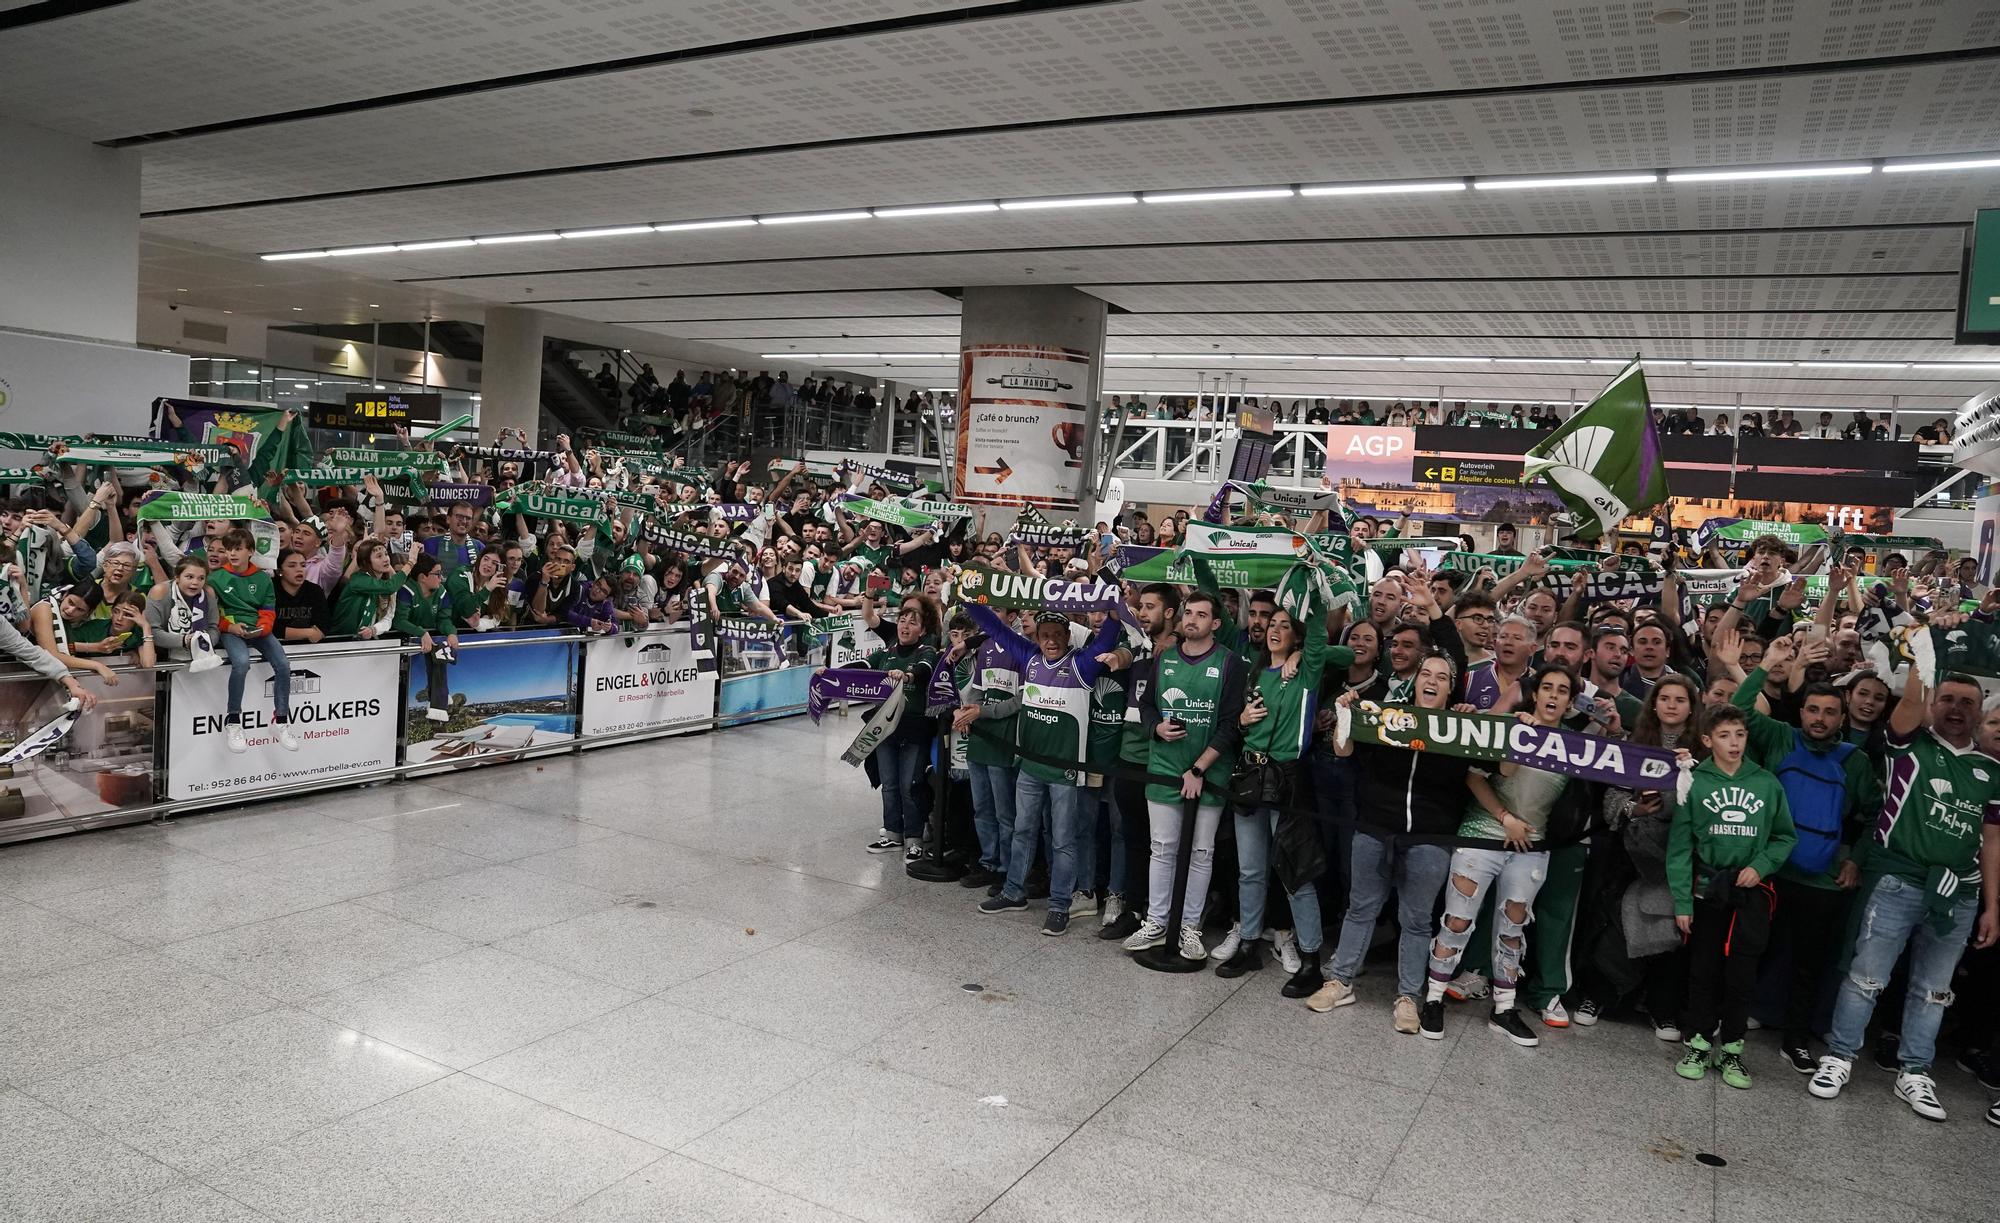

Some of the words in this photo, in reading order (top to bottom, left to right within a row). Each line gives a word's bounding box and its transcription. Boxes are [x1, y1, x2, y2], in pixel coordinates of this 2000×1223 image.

[1010, 378, 1018, 386] LA
[977, 413, 995, 423] ¿Café
[1005, 415, 1039, 424] brunch?
[1346, 435, 1403, 457] AGP
[464, 445, 551, 460] UNICAJA
[847, 459, 910, 483] UICAJA
[1459, 461, 1495, 470] Autoverleih
[1458, 475, 1483, 485] Alquiler
[179, 493, 234, 504] UNICAJA
[427, 488, 480, 500] ALONCESTO
[609, 492, 646, 505] nicaja
[1273, 493, 1306, 505] Unicaja
[172, 504, 246, 518] BALONCESTO
[863, 506, 905, 524] BALONCESTO
[1752, 521, 1791, 532] UNICAJA
[644, 525, 737, 560] UNICAJA
[1229, 540, 1258, 549] Unicaja
[990, 573, 1121, 604] UNICAJA
[1692, 580, 1727, 590] Unicaja
[1699, 594, 1713, 605] 43
[618, 695, 626, 703] El
[627, 693, 652, 702] Rosario
[656, 689, 685, 698] Marbella
[1039, 697, 1066, 707] Unicaja
[1185, 699, 1215, 710] Unicaja
[1027, 709, 1059, 724] málaga
[303, 728, 350, 740] Marbella
[1427, 714, 1625, 774] UNICAJA
[1464, 749, 1582, 774] BALONCESTO
[188, 783, 209, 793] Tel.:
[211, 779, 231, 789] 952
[234, 776, 247, 786] 86
[249, 774, 262, 784] 84
[265, 772, 277, 782] 06
[283, 758, 381, 779] www.marbella-ev.com
[1702, 787, 1764, 815] CELTICS
